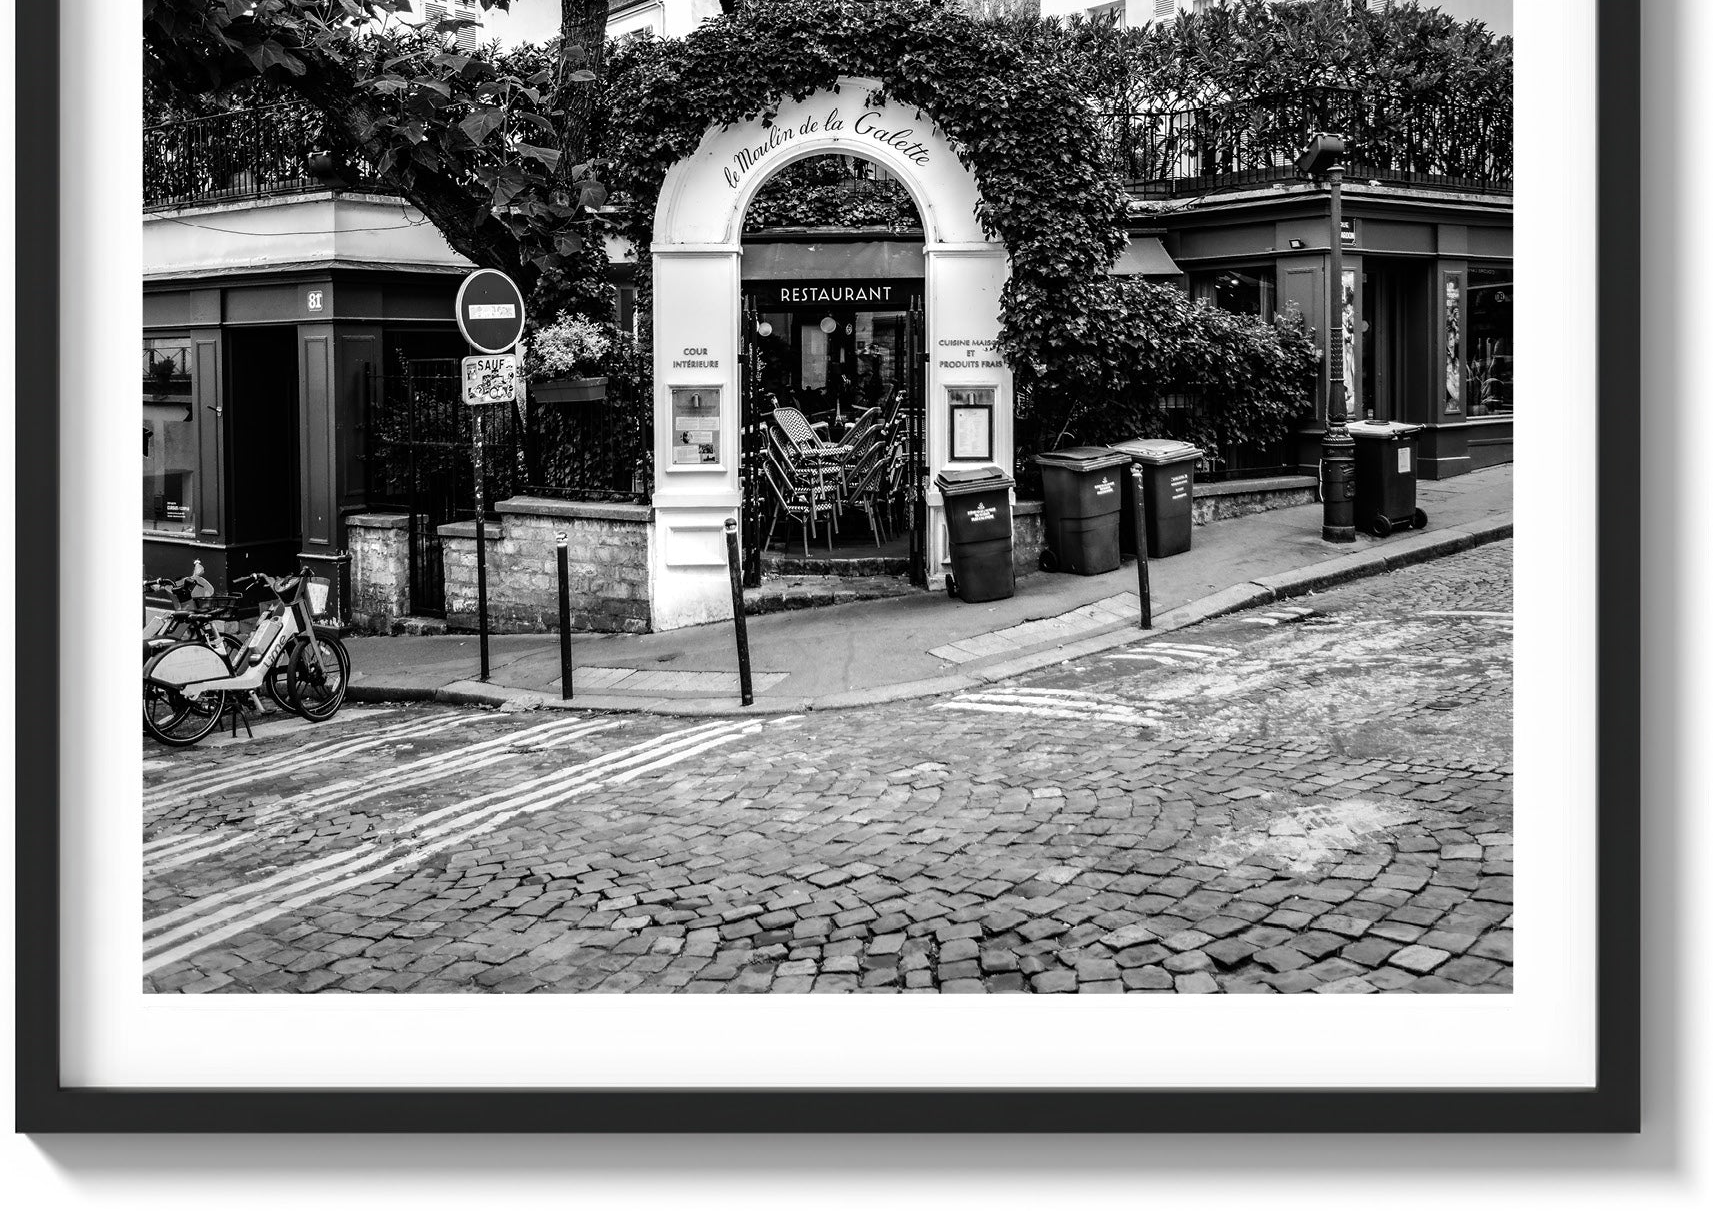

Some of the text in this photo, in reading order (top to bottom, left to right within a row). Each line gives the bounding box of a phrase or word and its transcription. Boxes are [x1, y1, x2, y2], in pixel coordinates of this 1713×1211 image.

[723, 107, 930, 189] le Moulin de la Galette
[781, 286, 892, 302] RESTAURANT
[308, 292, 322, 309] 81
[971, 339, 997, 347] MAIS
[683, 347, 708, 356] COUR
[966, 349, 976, 357] ET
[477, 358, 505, 371] SAUF
[672, 359, 719, 369] INTÉRIEURE
[939, 360, 1003, 368] PRODUITS FRAIS
[263, 635, 287, 668] Lime
